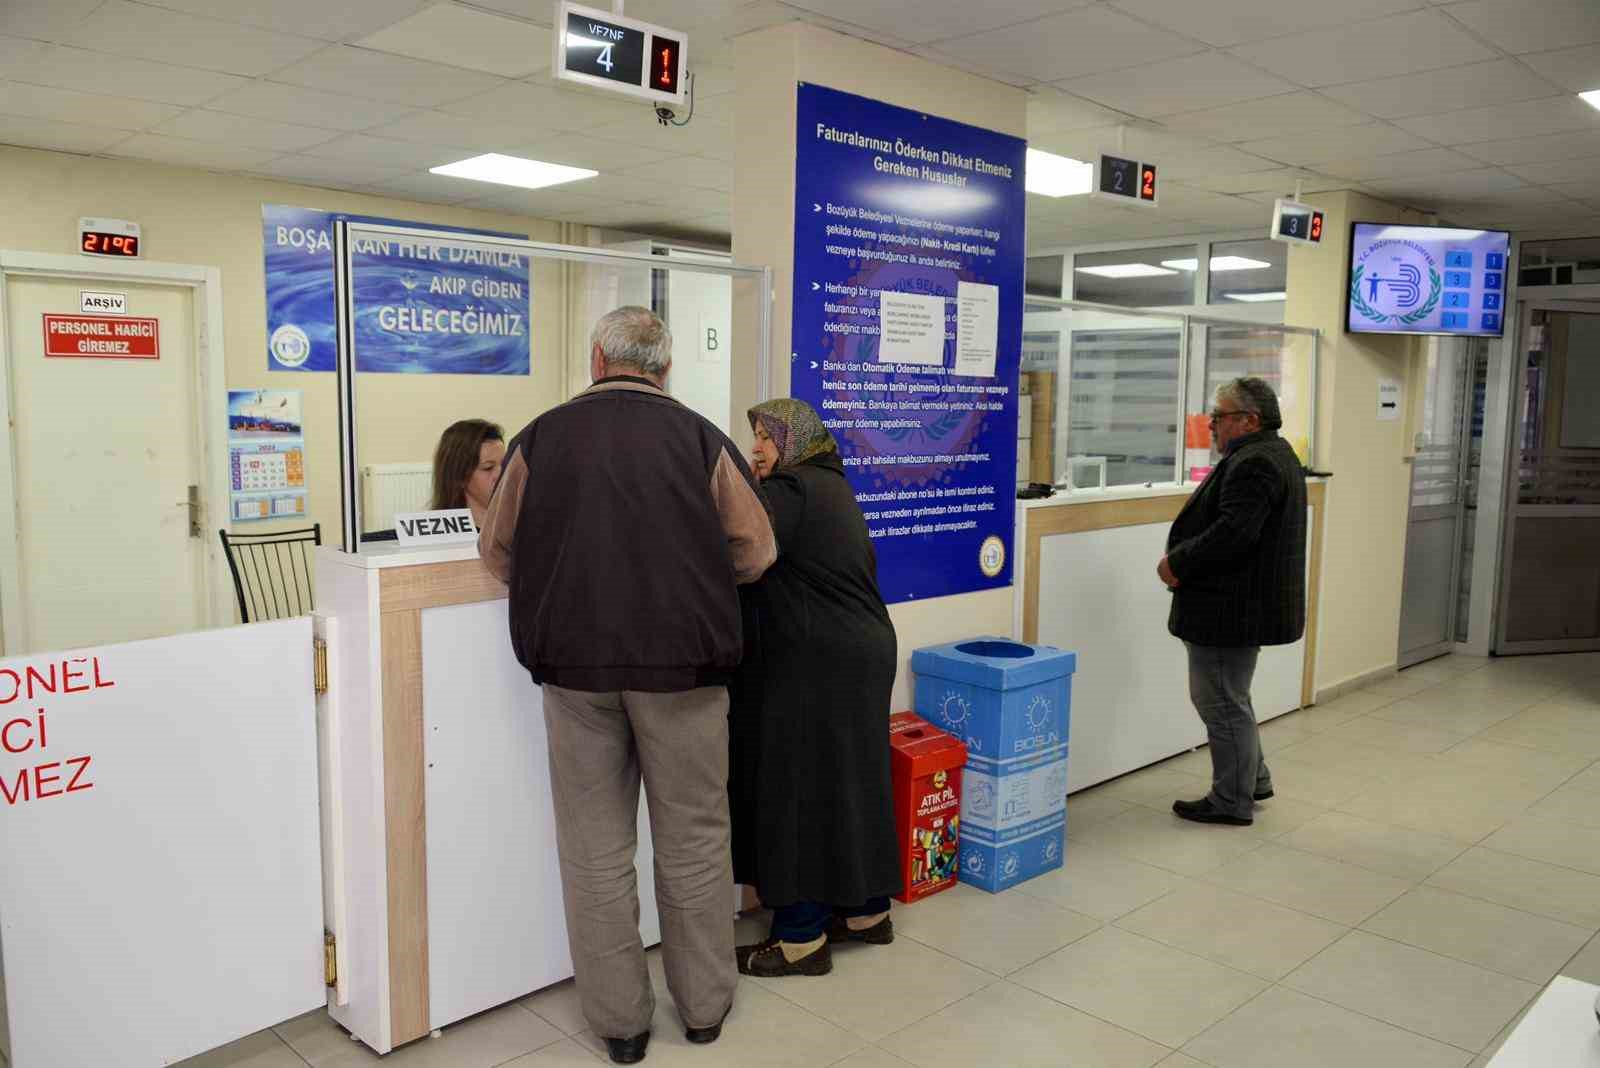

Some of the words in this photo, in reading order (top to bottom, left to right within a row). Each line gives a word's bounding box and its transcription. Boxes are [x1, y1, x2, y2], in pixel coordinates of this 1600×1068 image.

[596, 43, 615, 73] 4
[815, 122, 892, 153] Faturalarınızı
[895, 136, 940, 164] Öderken
[941, 150, 973, 171] Dikkat
[975, 158, 1012, 178] Etmeniz
[873, 155, 919, 178] Gereken
[921, 166, 967, 188] Hususlar
[1114, 171, 1122, 191] 2
[1144, 170, 1153, 195] 2
[1290, 217, 1297, 234] 3
[1312, 216, 1321, 238] 3
[276, 226, 332, 254] BOŞA
[429, 275, 467, 296] AKIP
[471, 275, 522, 299] GİDEN
[825, 281, 858, 297] Herhangi
[1454, 275, 1460, 286] 3
[84, 297, 123, 309] ARŞİV
[1449, 295, 1457, 305] 2
[379, 305, 522, 336] GELECEĞİMİZ
[859, 307, 876, 318] veya
[50, 321, 112, 336] PERSONEL
[114, 322, 154, 338] HARİCİ
[707, 327, 718, 351] B
[78, 339, 130, 354] GİREMEZ
[847, 382, 862, 391] son
[399, 516, 473, 537] VEZNE
[920, 791, 943, 809] ATIK
